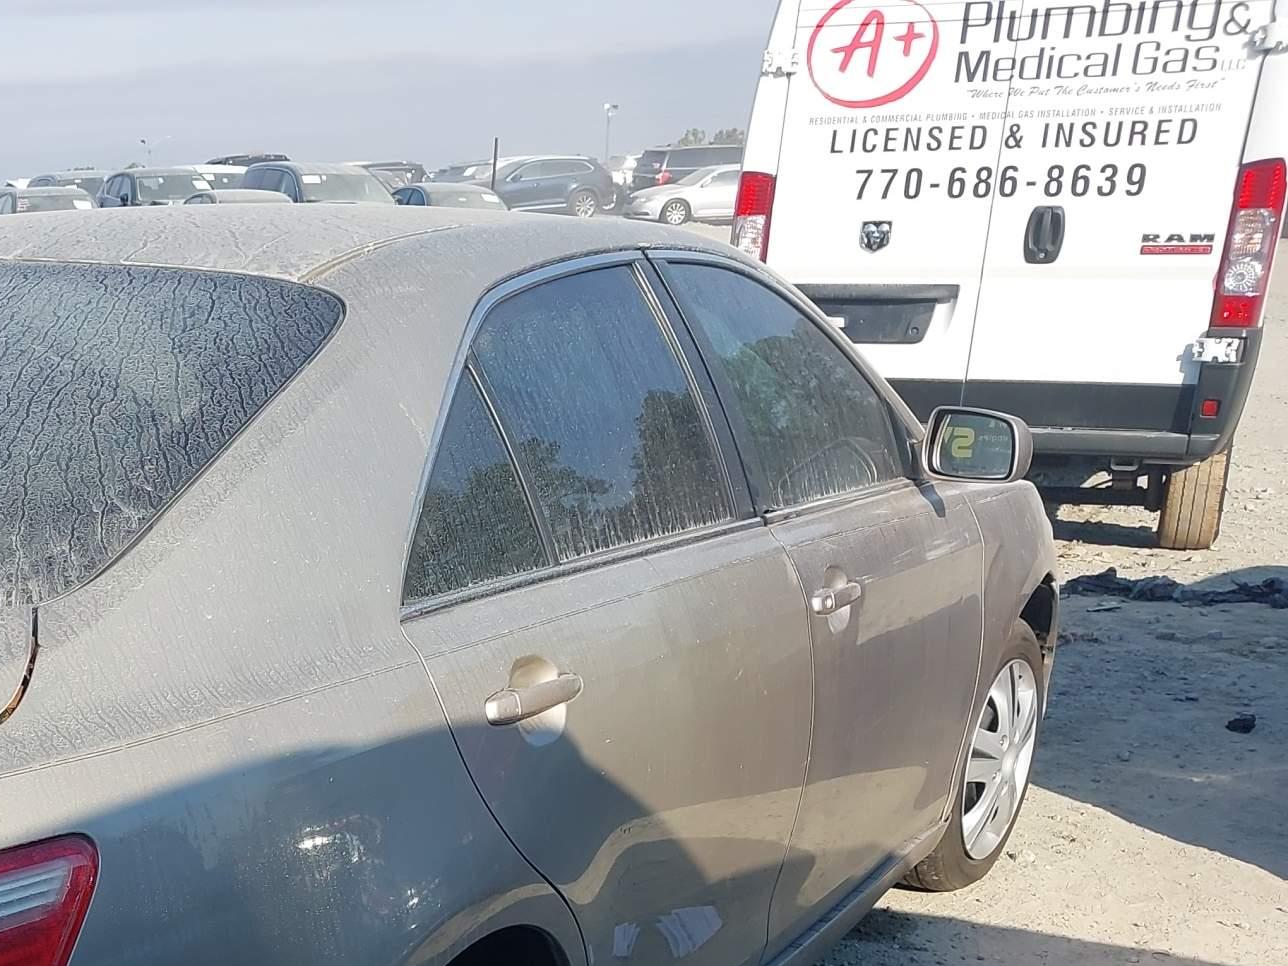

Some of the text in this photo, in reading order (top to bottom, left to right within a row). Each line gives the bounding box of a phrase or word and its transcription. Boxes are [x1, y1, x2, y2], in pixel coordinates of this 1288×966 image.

[831, 9, 926, 78] A+
[954, 43, 1122, 83] Medical
[1131, 41, 1220, 75] Gas
[1009, 87, 1025, 97] We
[1028, 86, 1051, 97] Put
[1054, 85, 1073, 95] The
[1145, 81, 1181, 92] Needs
[808, 116, 859, 126] RESIDENTIAL
[870, 114, 923, 124] COMMERCIAL
[925, 112, 968, 122] PLUMBING
[979, 111, 1014, 120] MEDICAL
[1018, 110, 1034, 118] GAS
[1037, 108, 1096, 118] INSTALLATION
[1108, 106, 1145, 116] SERVICE
[1158, 103, 1222, 114] INSTALLATION
[830, 118, 1198, 154] LICENSED & INSURED
[855, 163, 1147, 200] 770-686-8639
[1141, 233, 1215, 243] RAM
